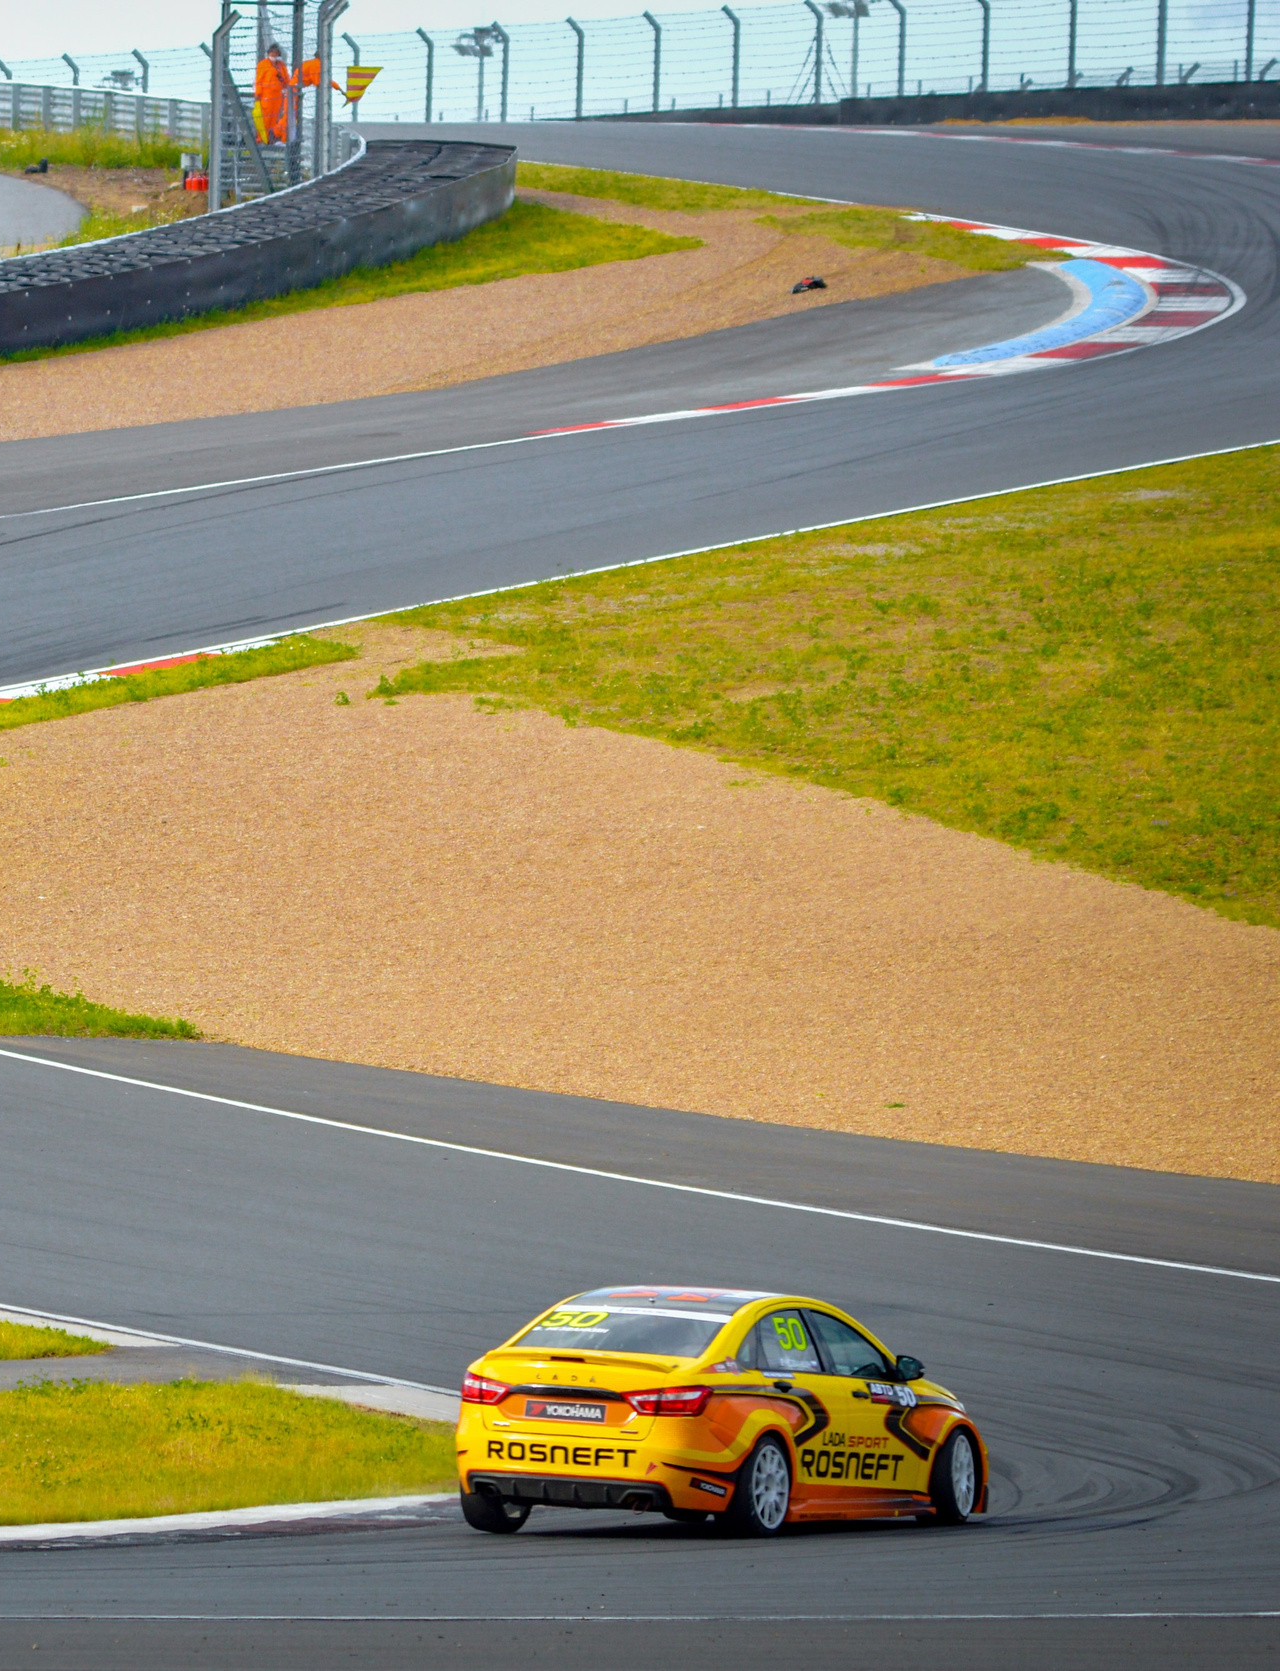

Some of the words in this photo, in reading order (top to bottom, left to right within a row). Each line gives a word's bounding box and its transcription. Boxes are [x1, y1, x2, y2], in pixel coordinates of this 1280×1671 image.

[541, 1311, 610, 1328] 50
[772, 1316, 808, 1351] 50
[535, 1372, 597, 1384] LADA
[870, 1382, 894, 1396] АВТО
[895, 1385, 916, 1408] 50
[545, 1403, 603, 1419] YOKOHAMA
[823, 1432, 845, 1447] LADA
[848, 1436, 889, 1448] SPORT
[486, 1439, 637, 1468] ROSNEFT
[802, 1449, 903, 1481] ROSNEFT
